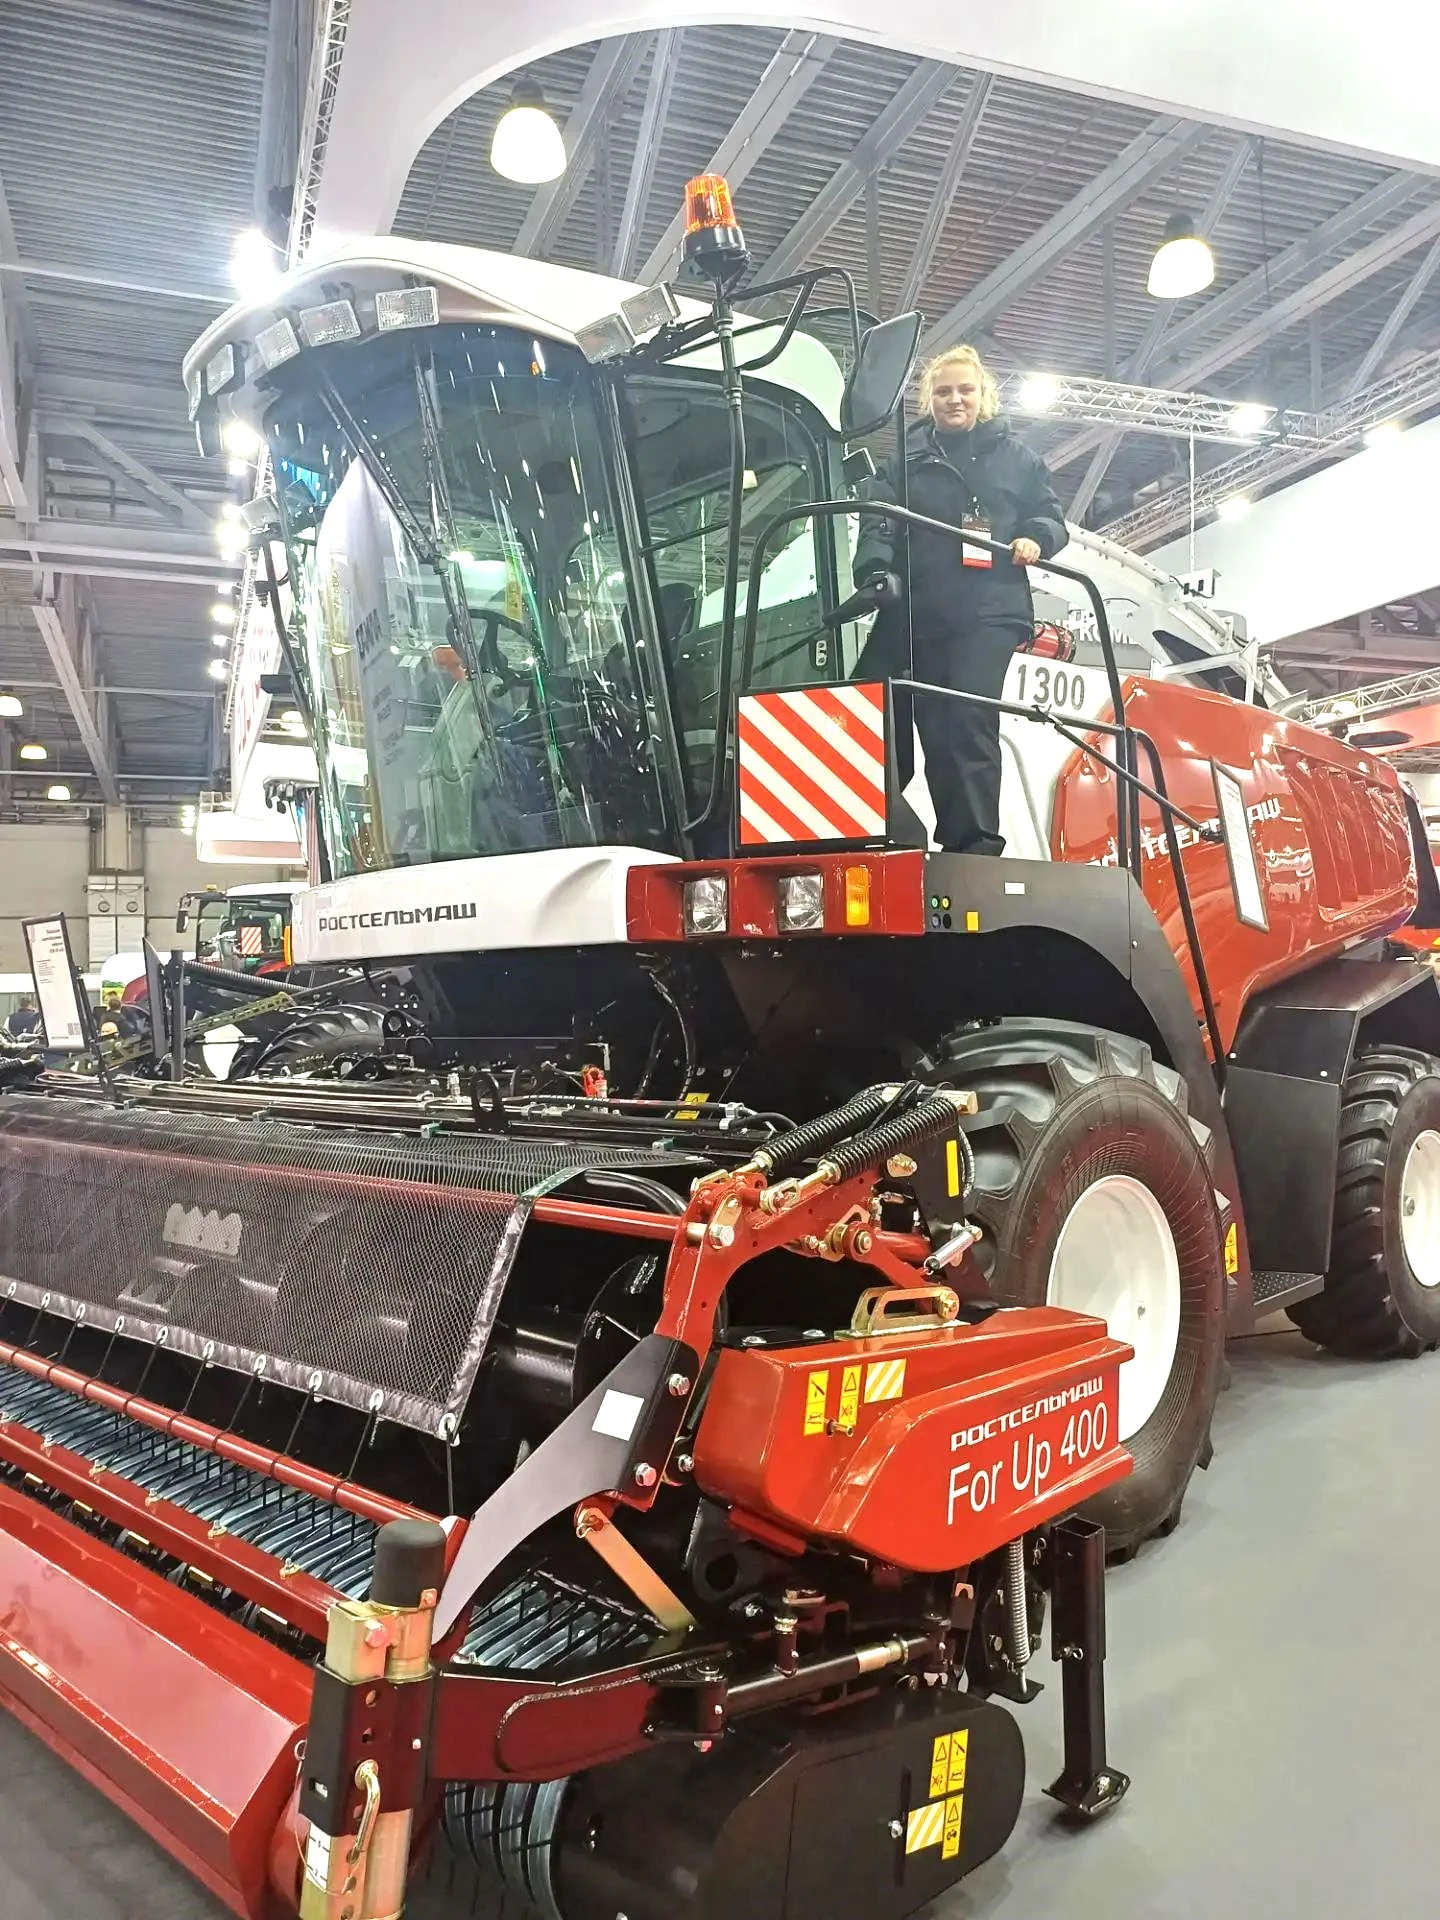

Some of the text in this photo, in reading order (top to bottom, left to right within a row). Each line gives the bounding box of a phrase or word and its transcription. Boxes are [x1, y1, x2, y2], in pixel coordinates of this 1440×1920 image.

[1017, 663, 1085, 711] 1300
[319, 902, 477, 932] РОСТСЕЛЬМАШ
[950, 1375, 1103, 1452] РОСТСЕЛЬМАШ
[947, 1401, 1108, 1526] For Up 400
